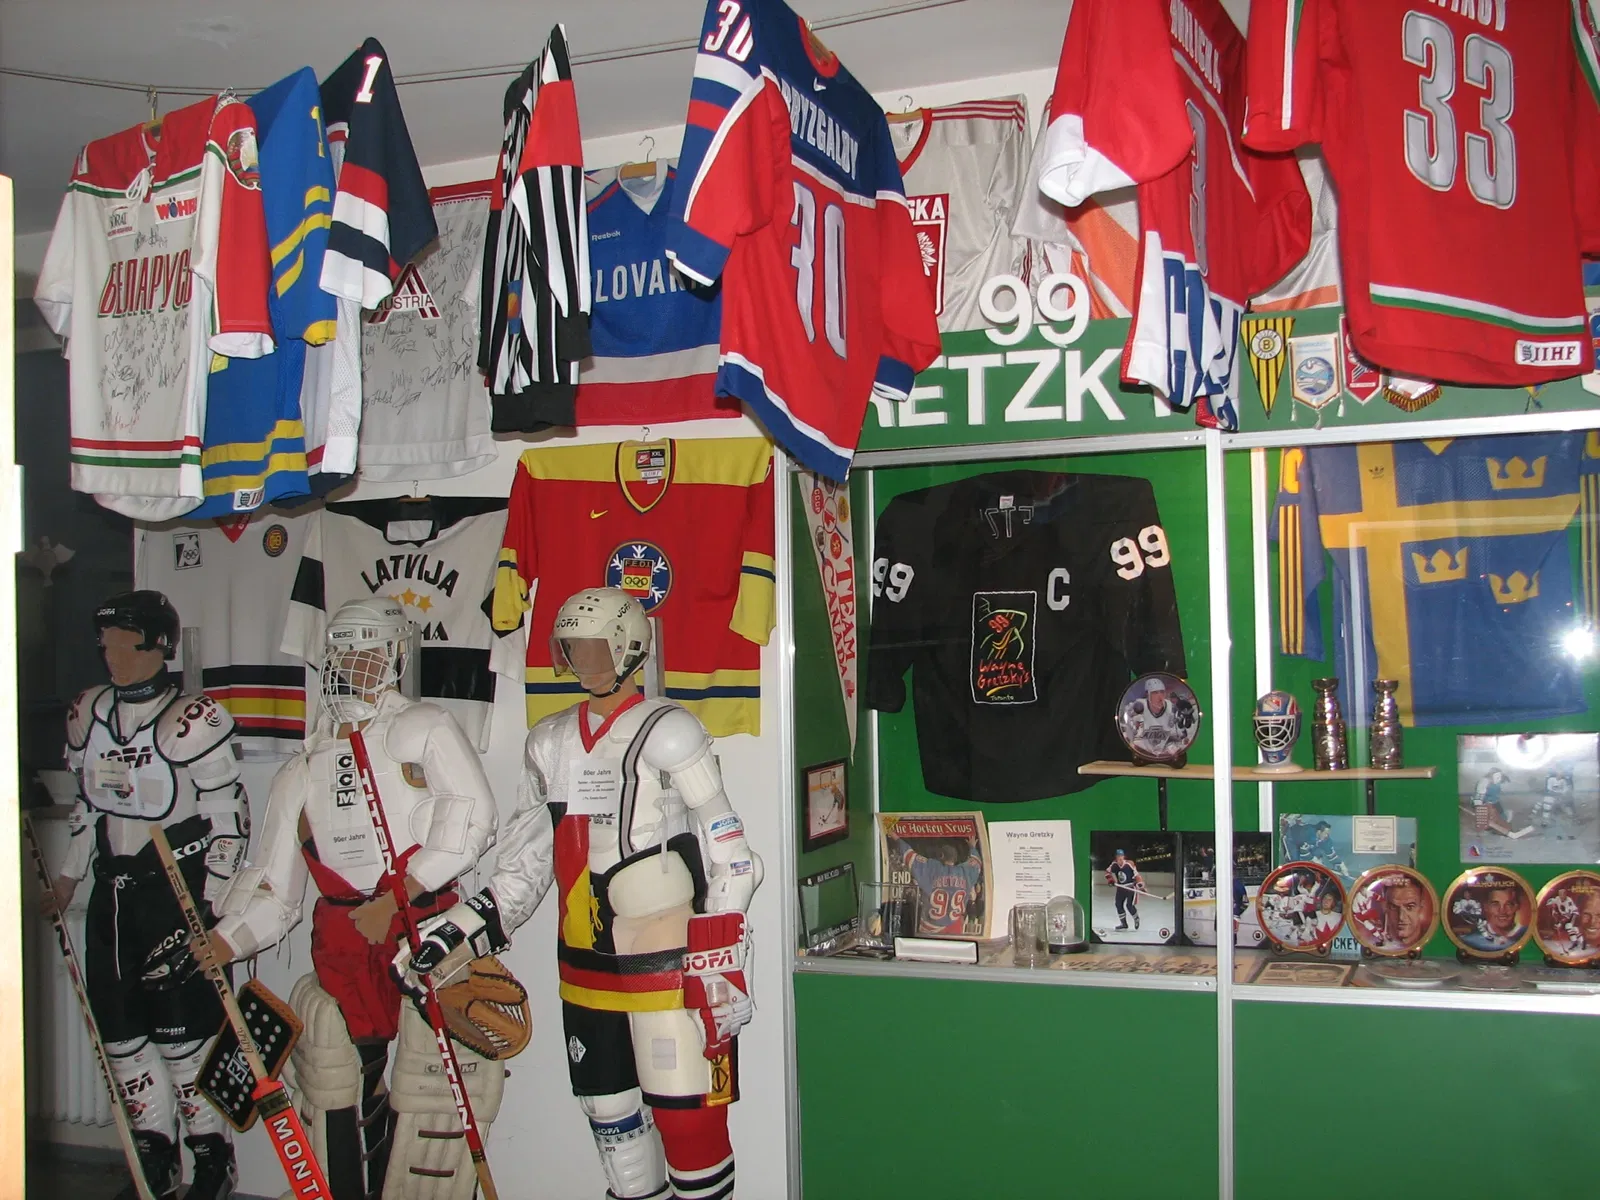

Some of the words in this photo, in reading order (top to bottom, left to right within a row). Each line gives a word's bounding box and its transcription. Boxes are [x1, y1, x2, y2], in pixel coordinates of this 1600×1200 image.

[355, 54, 384, 103] 1
[1401, 9, 1517, 210] 33
[591, 230, 621, 241] Reebok
[978, 272, 1091, 347] 99
[1109, 525, 1170, 580] 99
[360, 553, 460, 598] LATVIJA
[873, 557, 915, 603] 99
[1046, 567, 1071, 611] C
[556, 618, 579, 628] JOFA
[820, 558, 848, 678] CANADA
[835, 556, 856, 661] TEAM
[977, 660, 1025, 676] Wayne
[348, 833, 366, 842] Jahre
[361, 767, 398, 876] TITAN
[908, 822, 944, 835] Hockey
[944, 822, 972, 834] News
[1006, 831, 1028, 840] Wayne
[1029, 831, 1054, 840] Gretzky
[892, 871, 911, 884] END
[928, 888, 967, 921] 99
[683, 949, 734, 973] JOFA
[437, 1027, 472, 1130] TITAN
